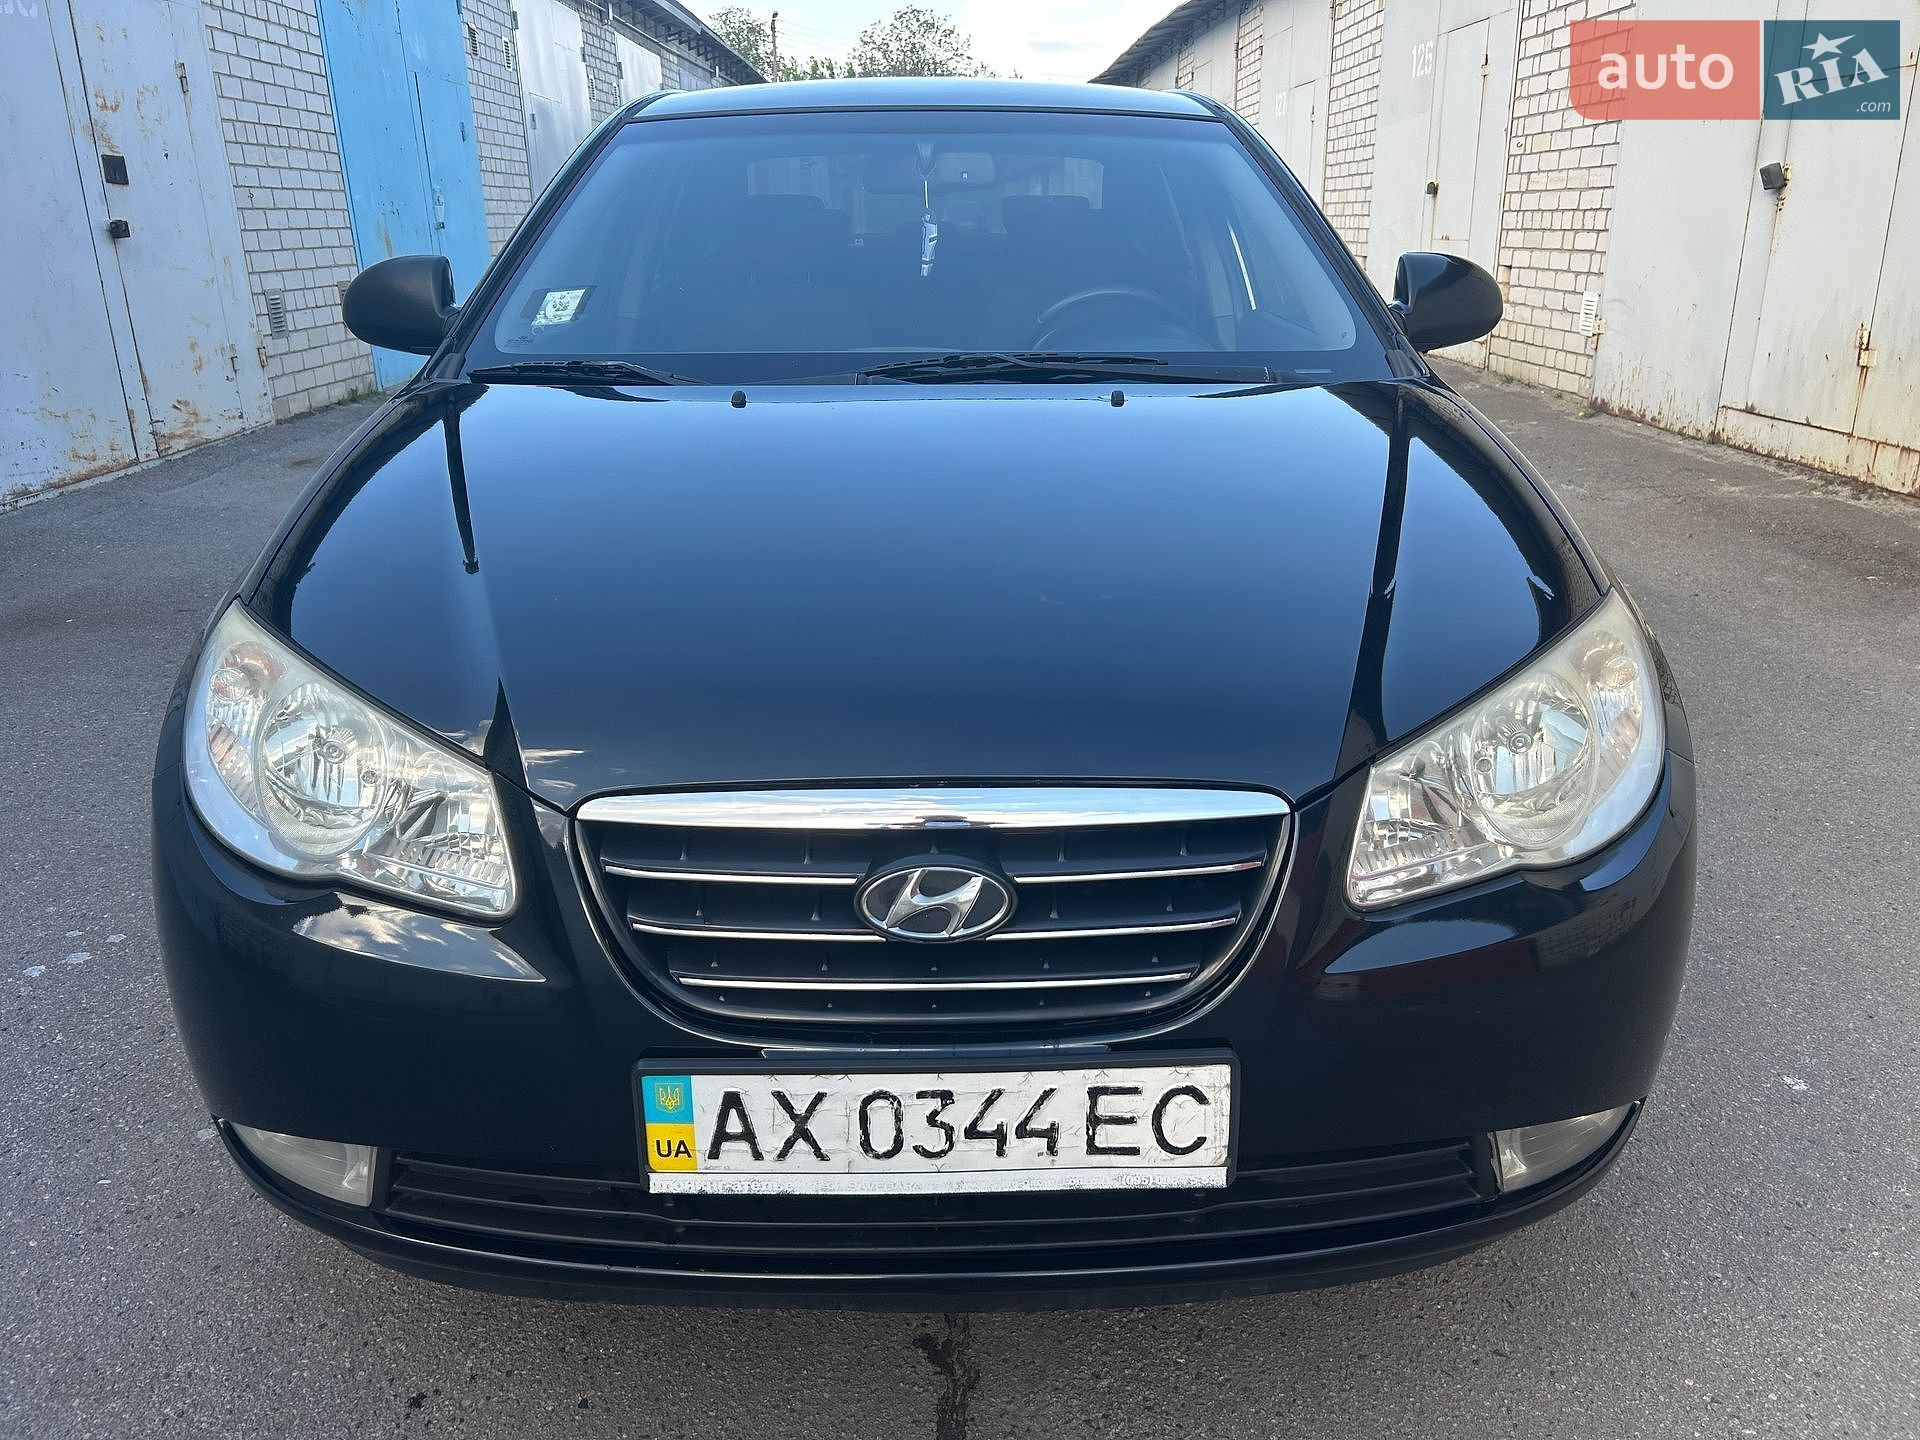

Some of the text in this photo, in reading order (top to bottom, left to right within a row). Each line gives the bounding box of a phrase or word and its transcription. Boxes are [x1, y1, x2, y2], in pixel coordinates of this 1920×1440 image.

[707, 1084, 1211, 1161] AX 0344 EC
[655, 1139, 693, 1158] UA
